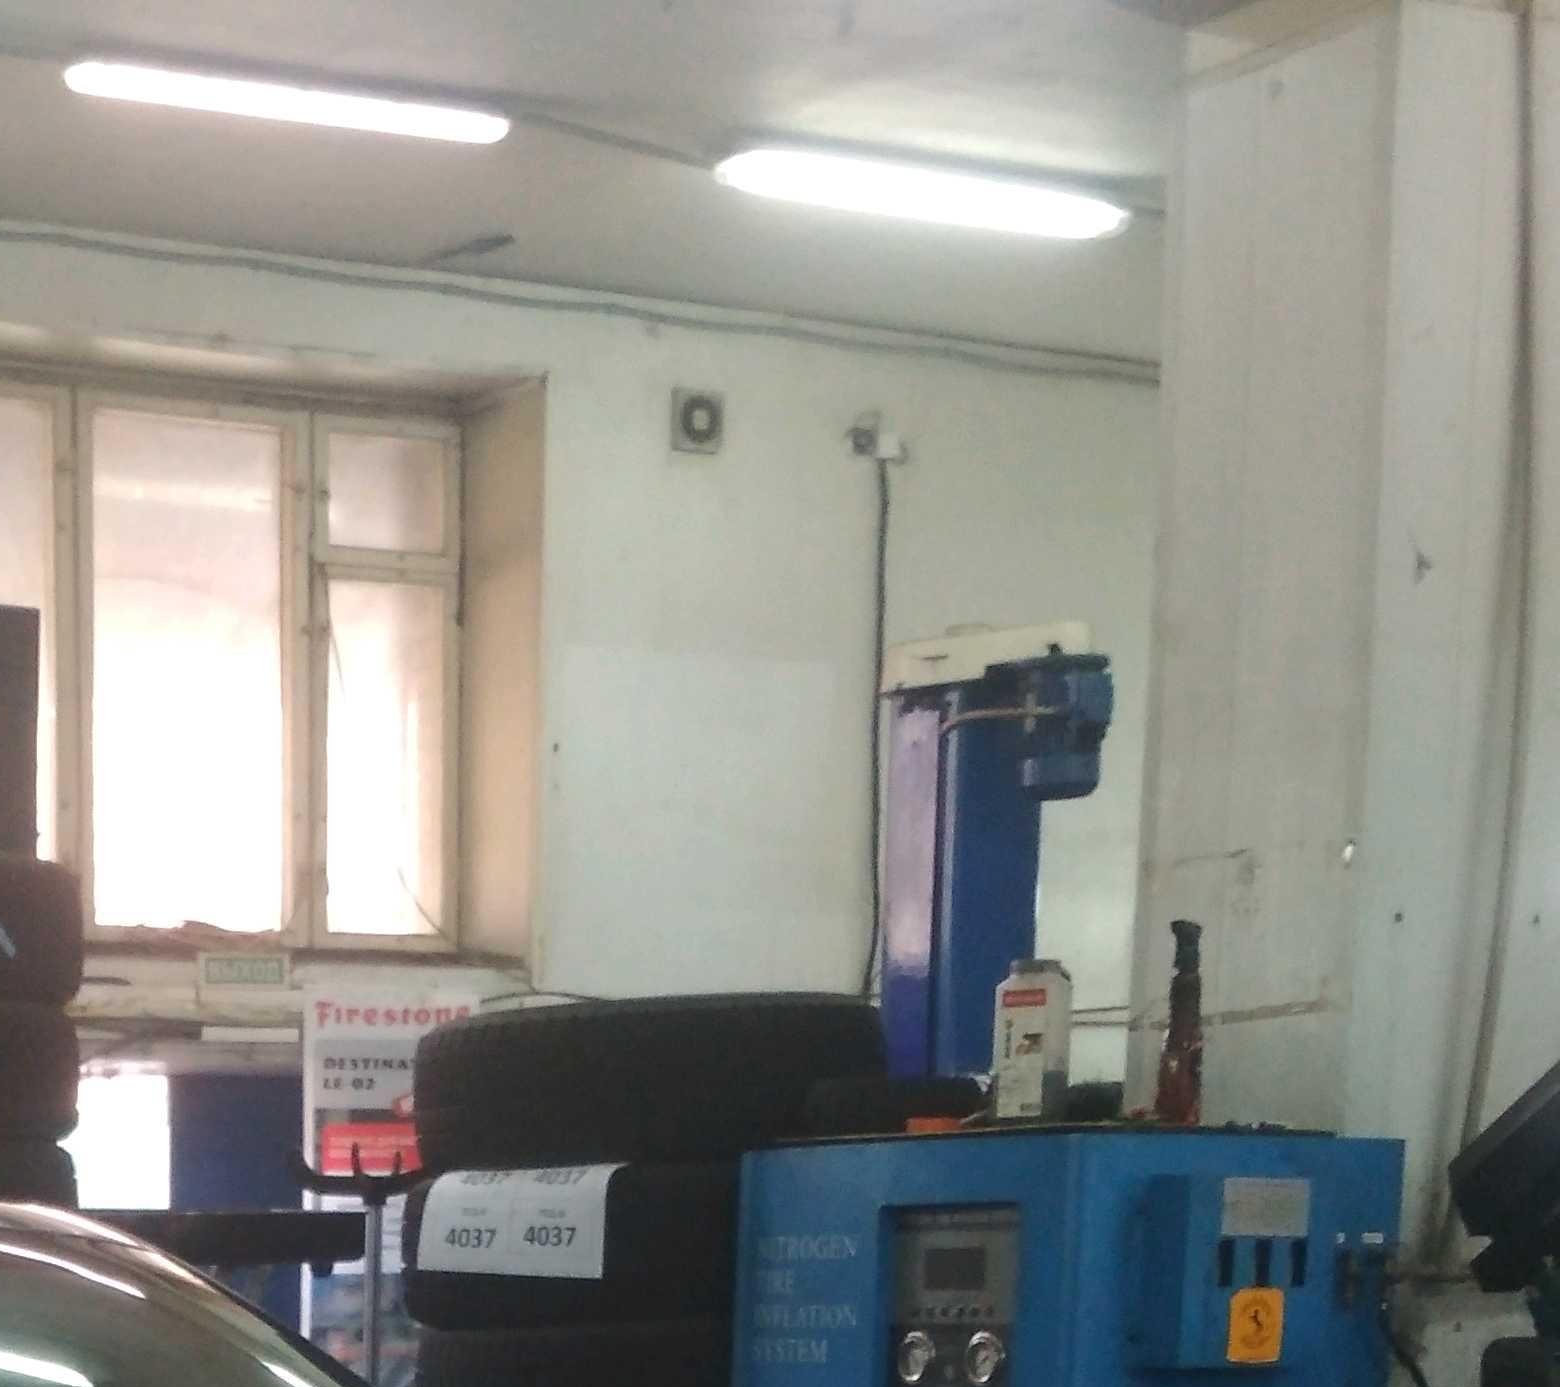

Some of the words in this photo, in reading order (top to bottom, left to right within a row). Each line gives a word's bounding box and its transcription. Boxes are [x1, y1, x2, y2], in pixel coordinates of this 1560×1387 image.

[324, 1057, 415, 1070] DESTINA
[445, 1228, 497, 1248] 4037
[523, 1226, 577, 1247] 4037
